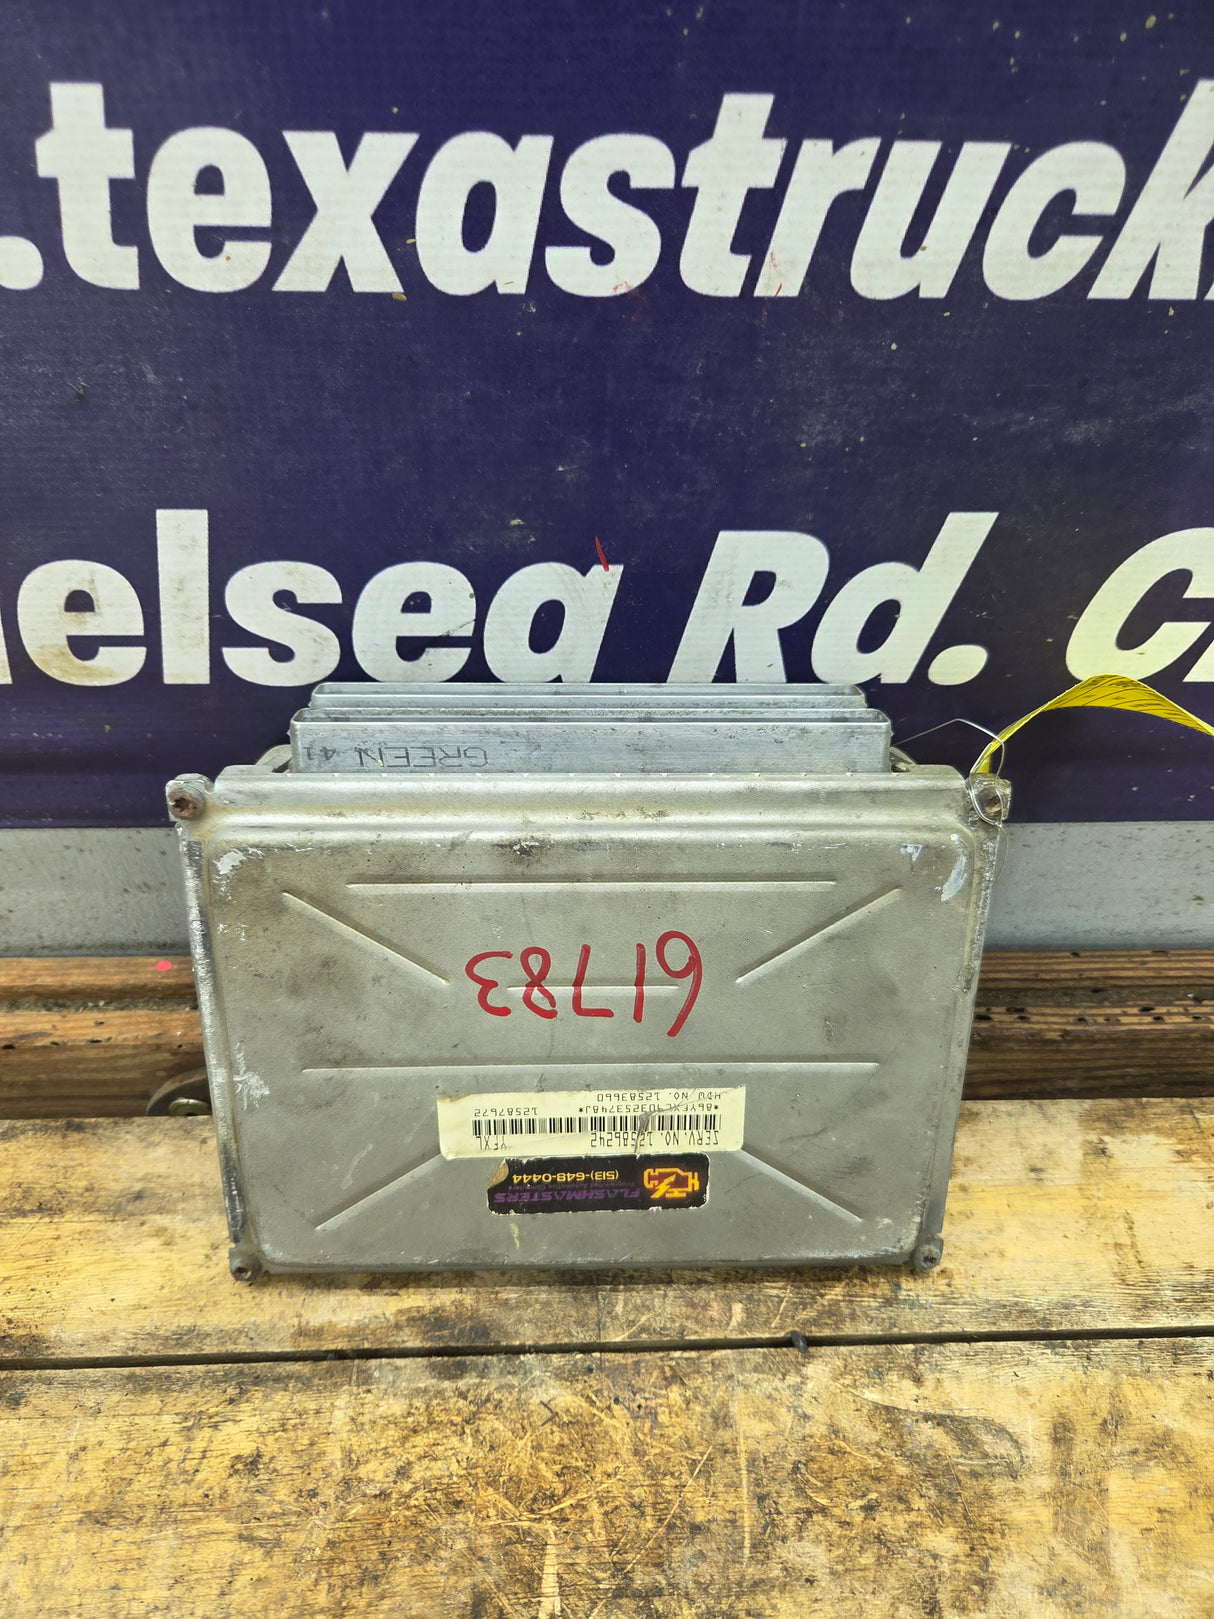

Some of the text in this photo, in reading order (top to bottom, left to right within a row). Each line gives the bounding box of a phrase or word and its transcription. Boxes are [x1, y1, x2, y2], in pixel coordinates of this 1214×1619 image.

[0, 78, 1214, 301] .texastruck
[0, 508, 1214, 687] elsea Rd. C
[303, 745, 489, 769] GREEN 41
[464, 930, 703, 1038] 61783
[596, 1091, 721, 1102] HDW NO. 12583660
[473, 1107, 538, 1117] 12587672
[475, 1130, 719, 1151] SERV. NO. 12586242 YFXL
[512, 1169, 620, 1184] (513)-648-0444
[494, 1187, 641, 1203] FLASHMASTERS
